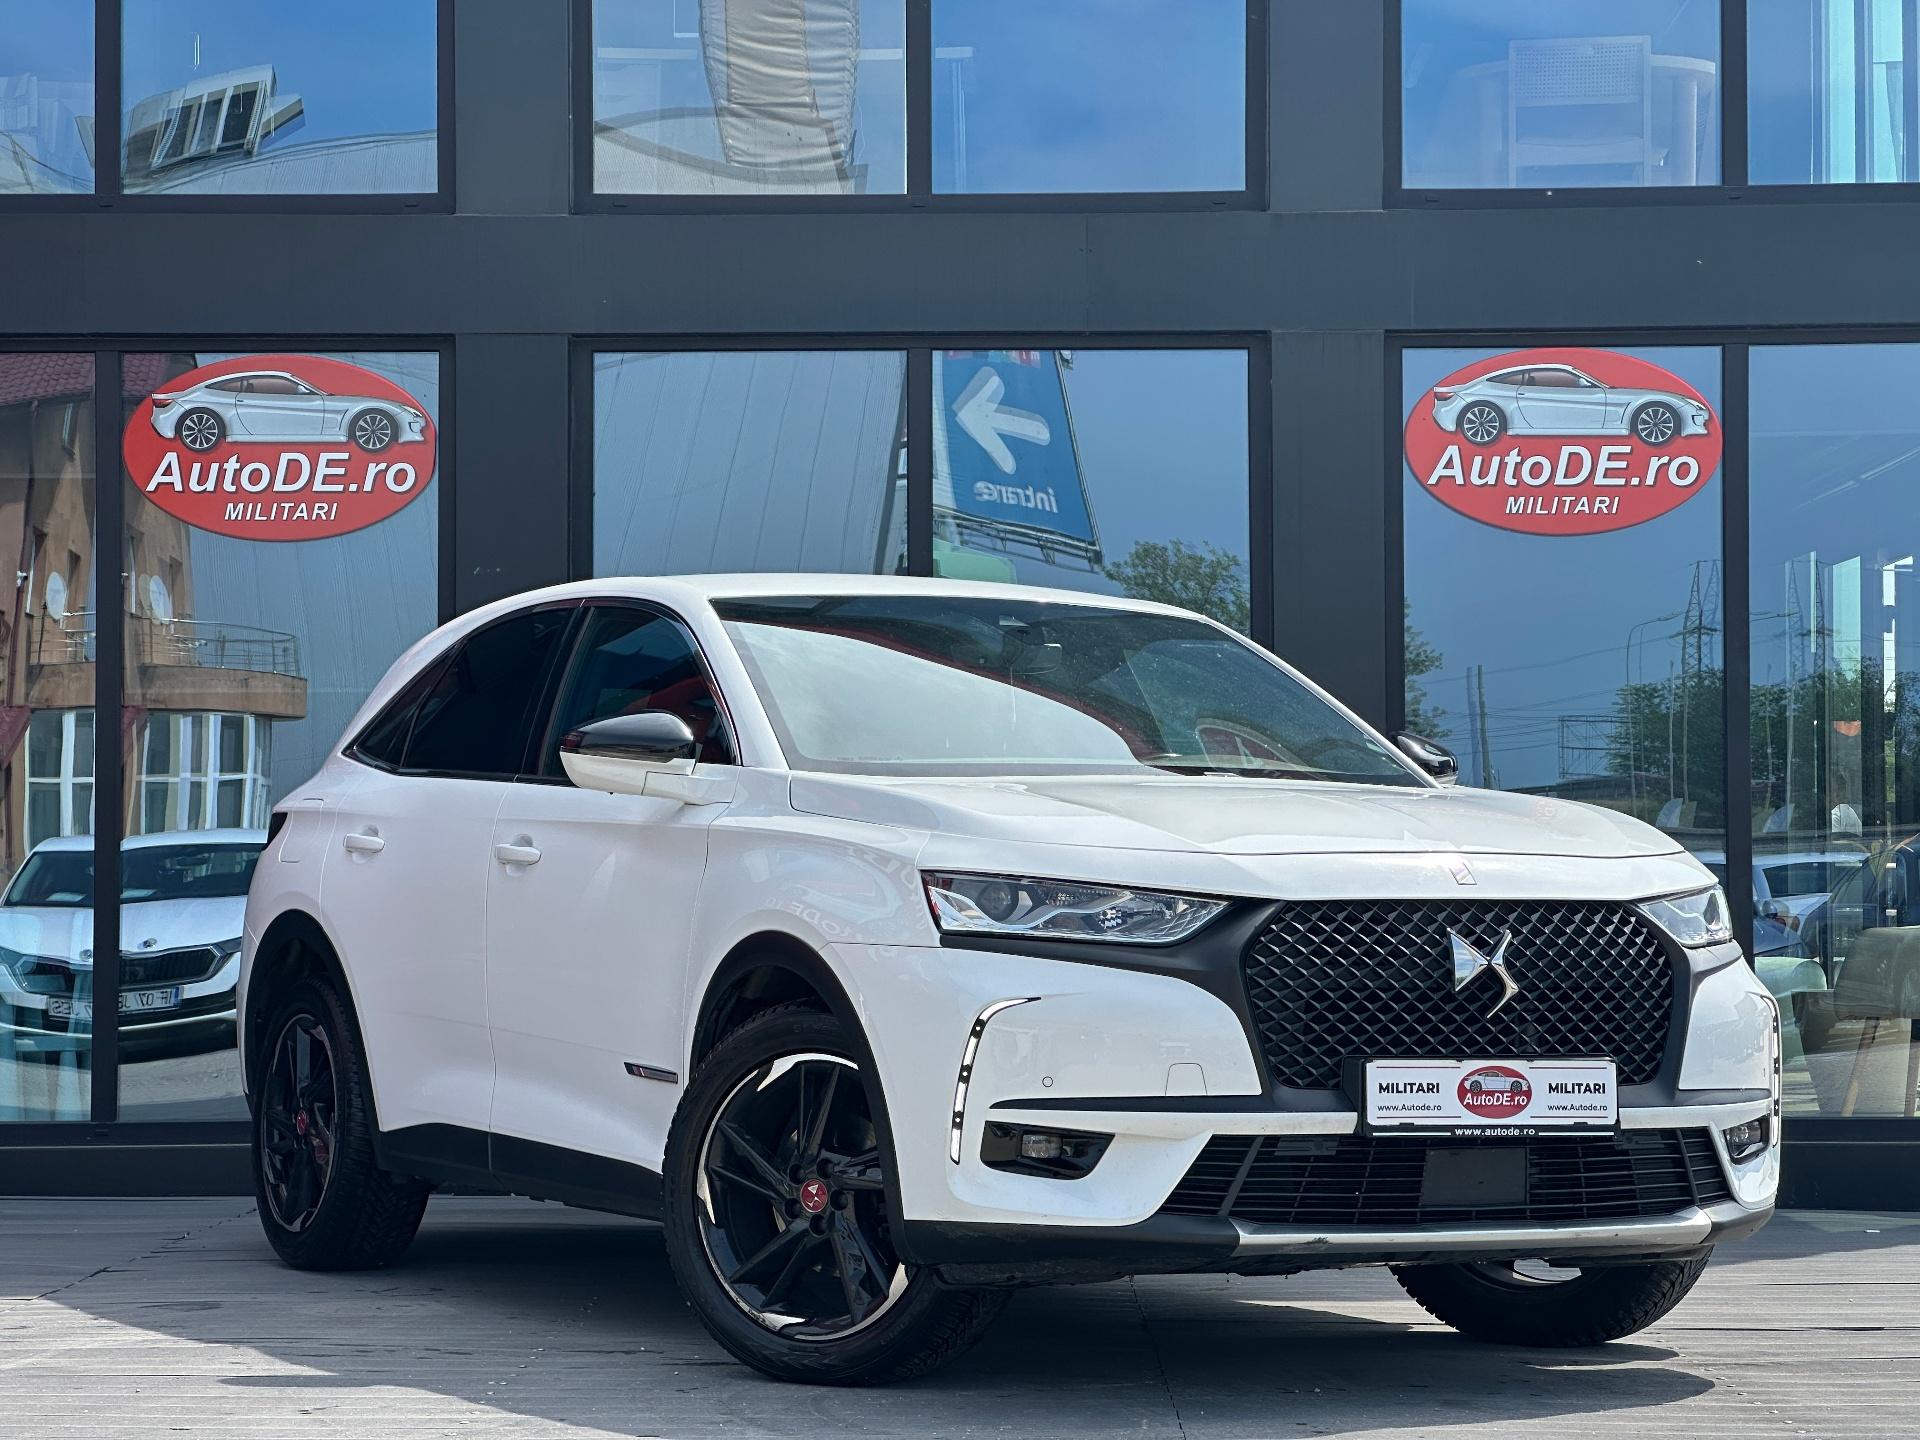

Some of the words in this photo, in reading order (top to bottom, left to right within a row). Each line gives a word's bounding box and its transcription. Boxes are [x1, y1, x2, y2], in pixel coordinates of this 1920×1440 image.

[145, 451, 416, 493] AutoDE.ro
[1426, 445, 1699, 486] AutoDE.ro
[224, 502, 338, 521] MILITARI
[1505, 496, 1620, 515] MILITARI
[1378, 1082, 1440, 1094] MILITARI
[1548, 1082, 1606, 1094] MILITARI
[1463, 1092, 1528, 1106] AutoDE.ro
[1377, 1103, 1442, 1111] www.Autode.ro
[1547, 1103, 1608, 1111] www.Autode.ro
[1454, 1127, 1536, 1136] www.autode.ro
